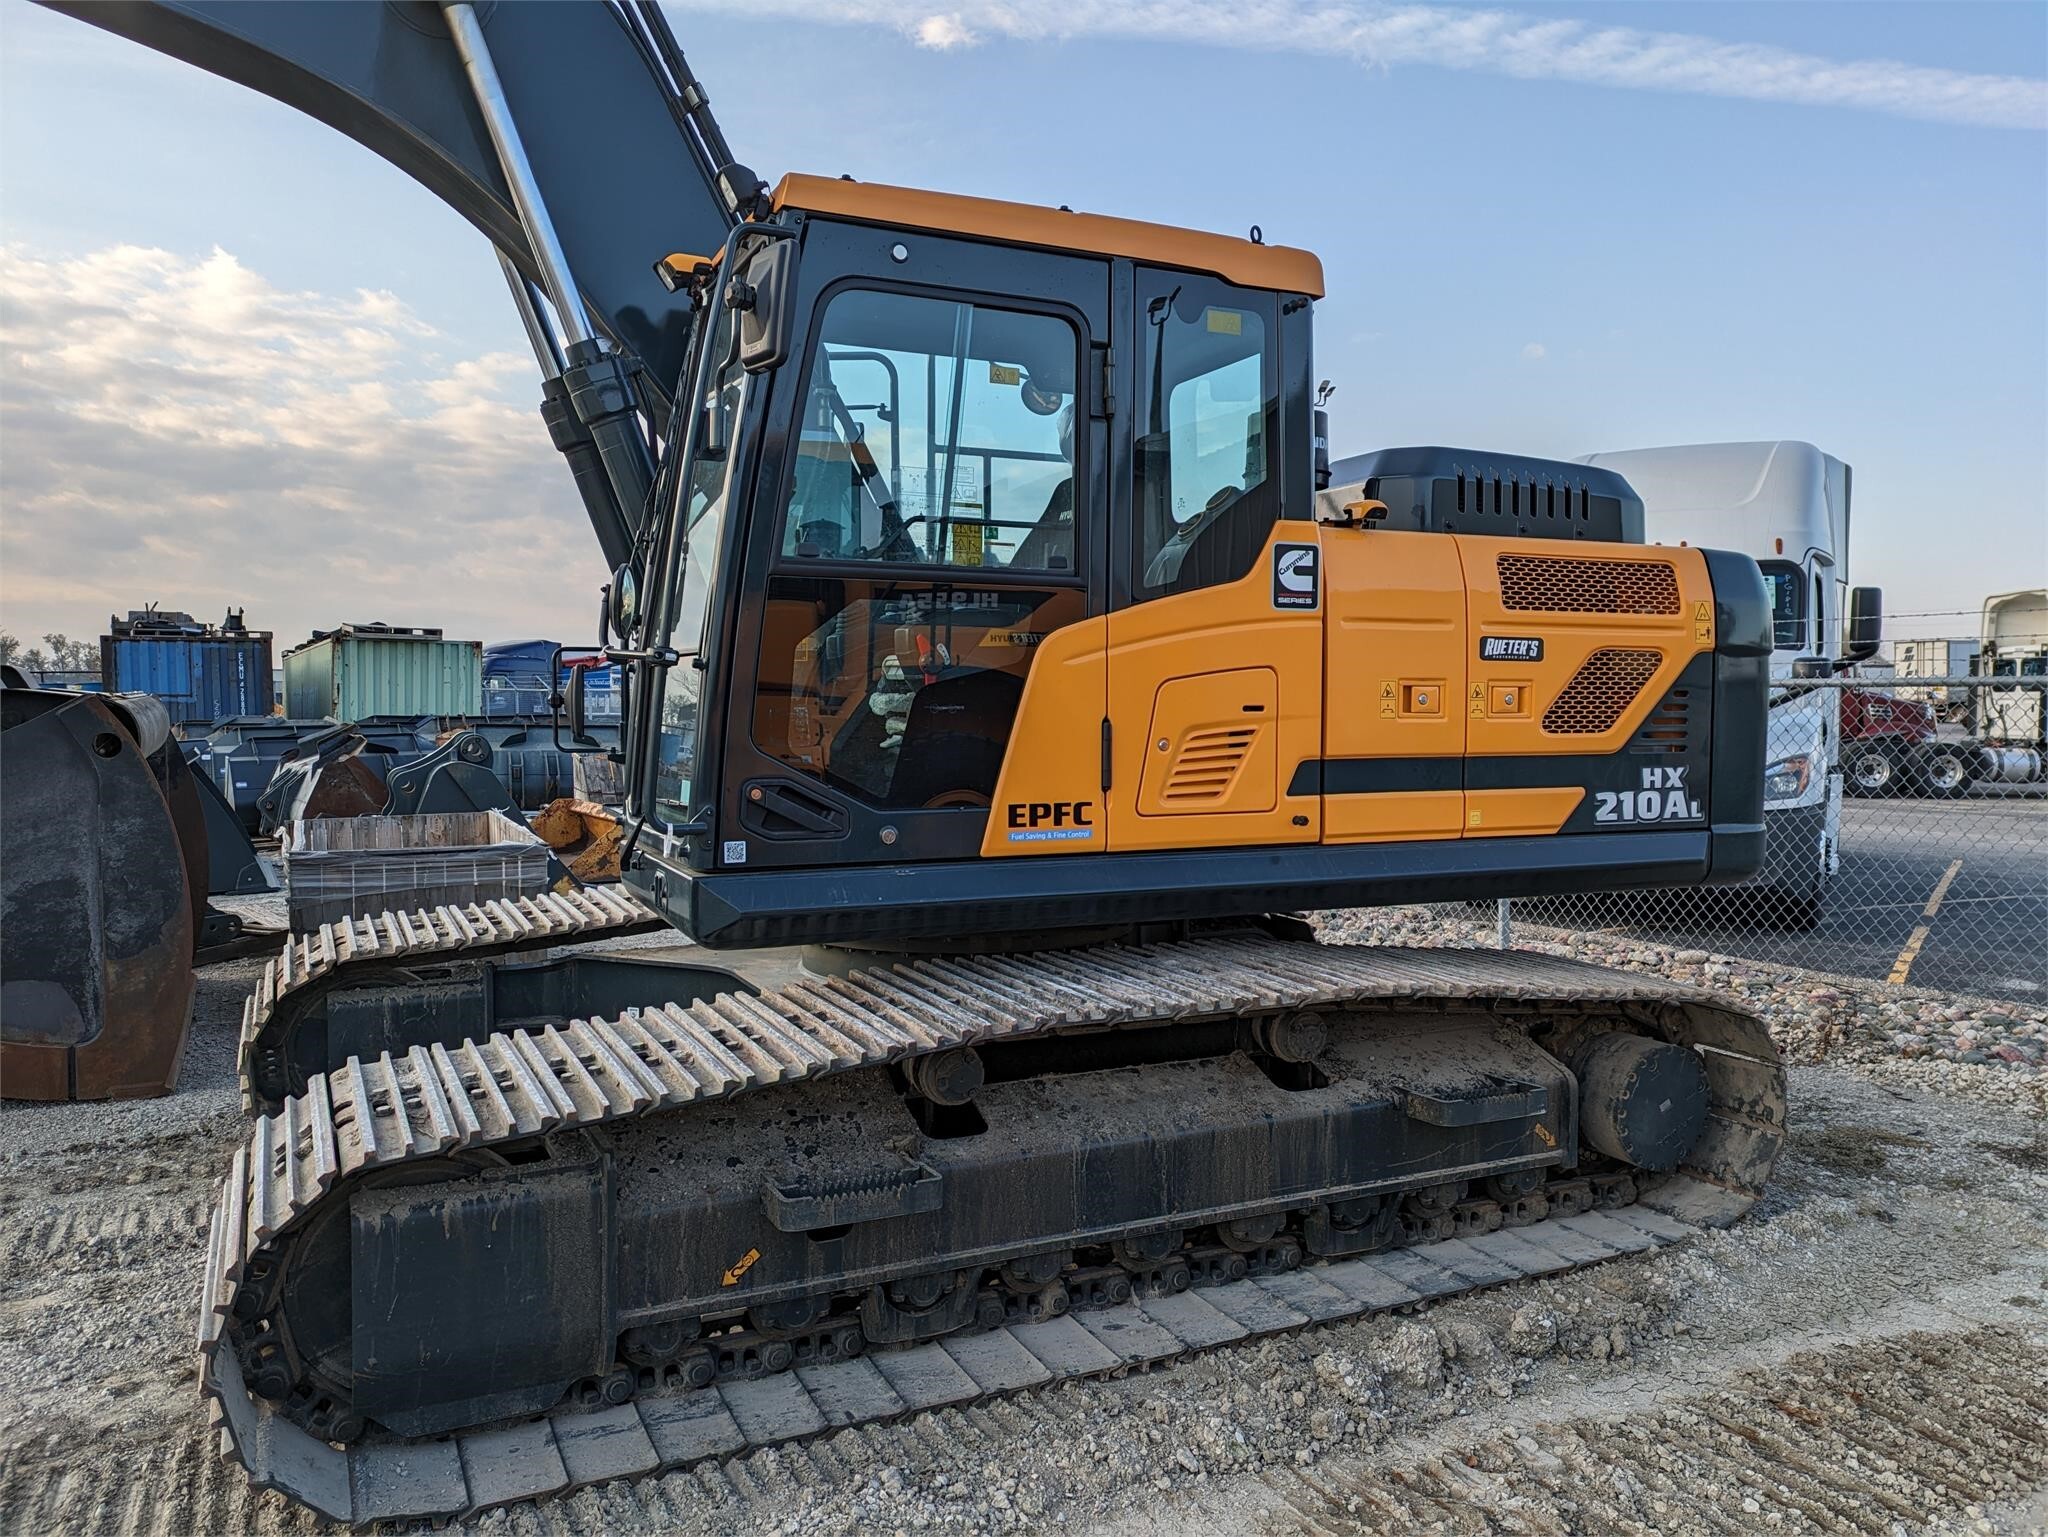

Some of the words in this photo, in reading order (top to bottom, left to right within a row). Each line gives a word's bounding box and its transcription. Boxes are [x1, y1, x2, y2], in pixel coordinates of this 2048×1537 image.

[1278, 550, 1311, 576] Cummins
[1484, 638, 1539, 656] RUETER'S
[1642, 767, 1685, 789] HX
[1008, 802, 1093, 828] EPFC
[1011, 832, 1024, 840] Fuel
[1025, 832, 1046, 840] Saving
[1053, 831, 1066, 839] Fine
[1067, 830, 1090, 838] Control
